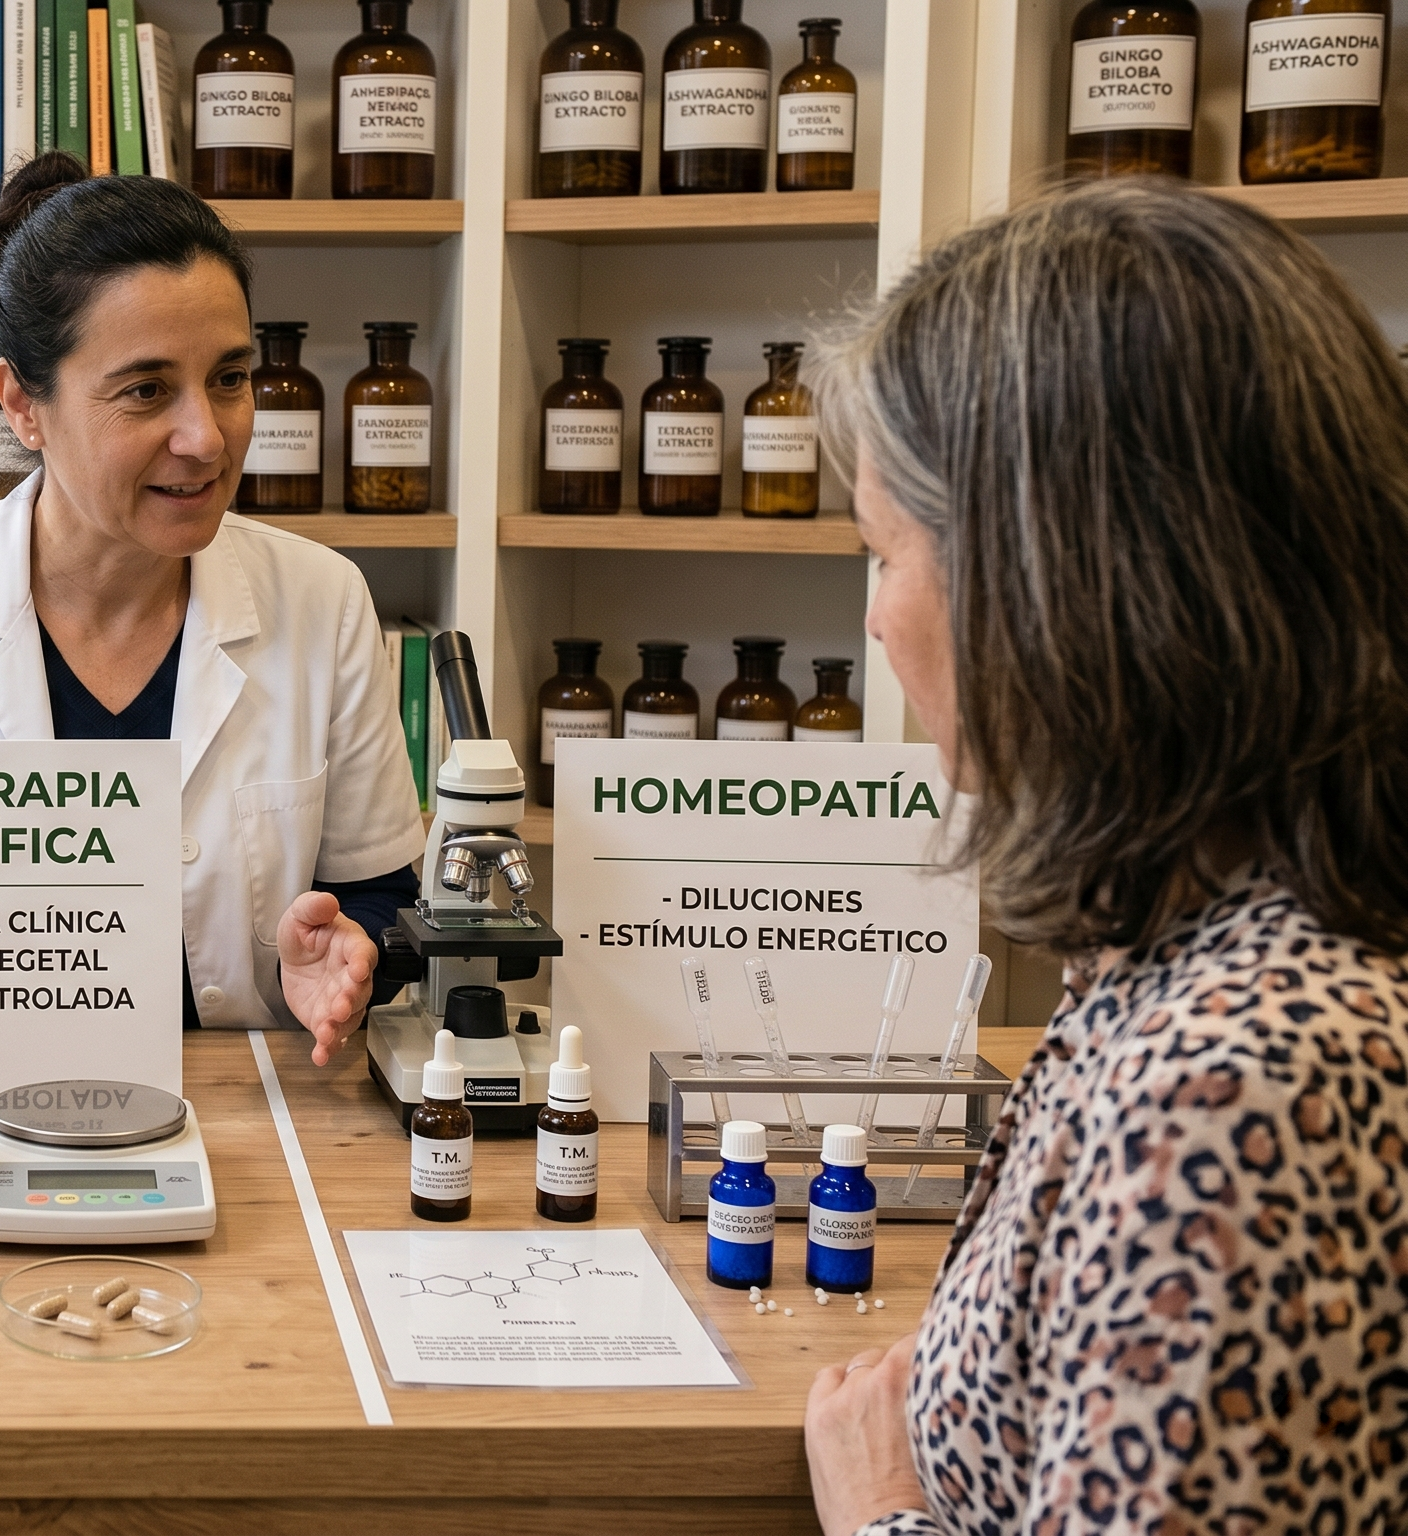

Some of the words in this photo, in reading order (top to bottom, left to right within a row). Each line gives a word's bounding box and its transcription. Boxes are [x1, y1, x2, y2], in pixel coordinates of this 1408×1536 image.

[1252, 35, 1380, 55] ASHWAGANDHA
[1269, 54, 1359, 71] EXTRACTO
[1100, 66, 1160, 80] BILOBA
[594, 90, 639, 102] BILOBA
[1088, 83, 1173, 98] EXTRACTO
[213, 106, 281, 117] EXTRACTO
[555, 106, 626, 118] EXTRACTO
[681, 104, 754, 117] EXTRACTO
[360, 116, 424, 127] EXTRACTO
[595, 772, 940, 818] HOMEOPATÍA
[682, 888, 862, 913] DILUCIONES
[9, 905, 125, 933] CLÍNICA
[600, 919, 747, 949] ESTÍMULO
[759, 924, 947, 953] ENERGÉTICO
[431, 1152, 461, 1164] T.M.
[559, 1147, 588, 1158] T.M.
